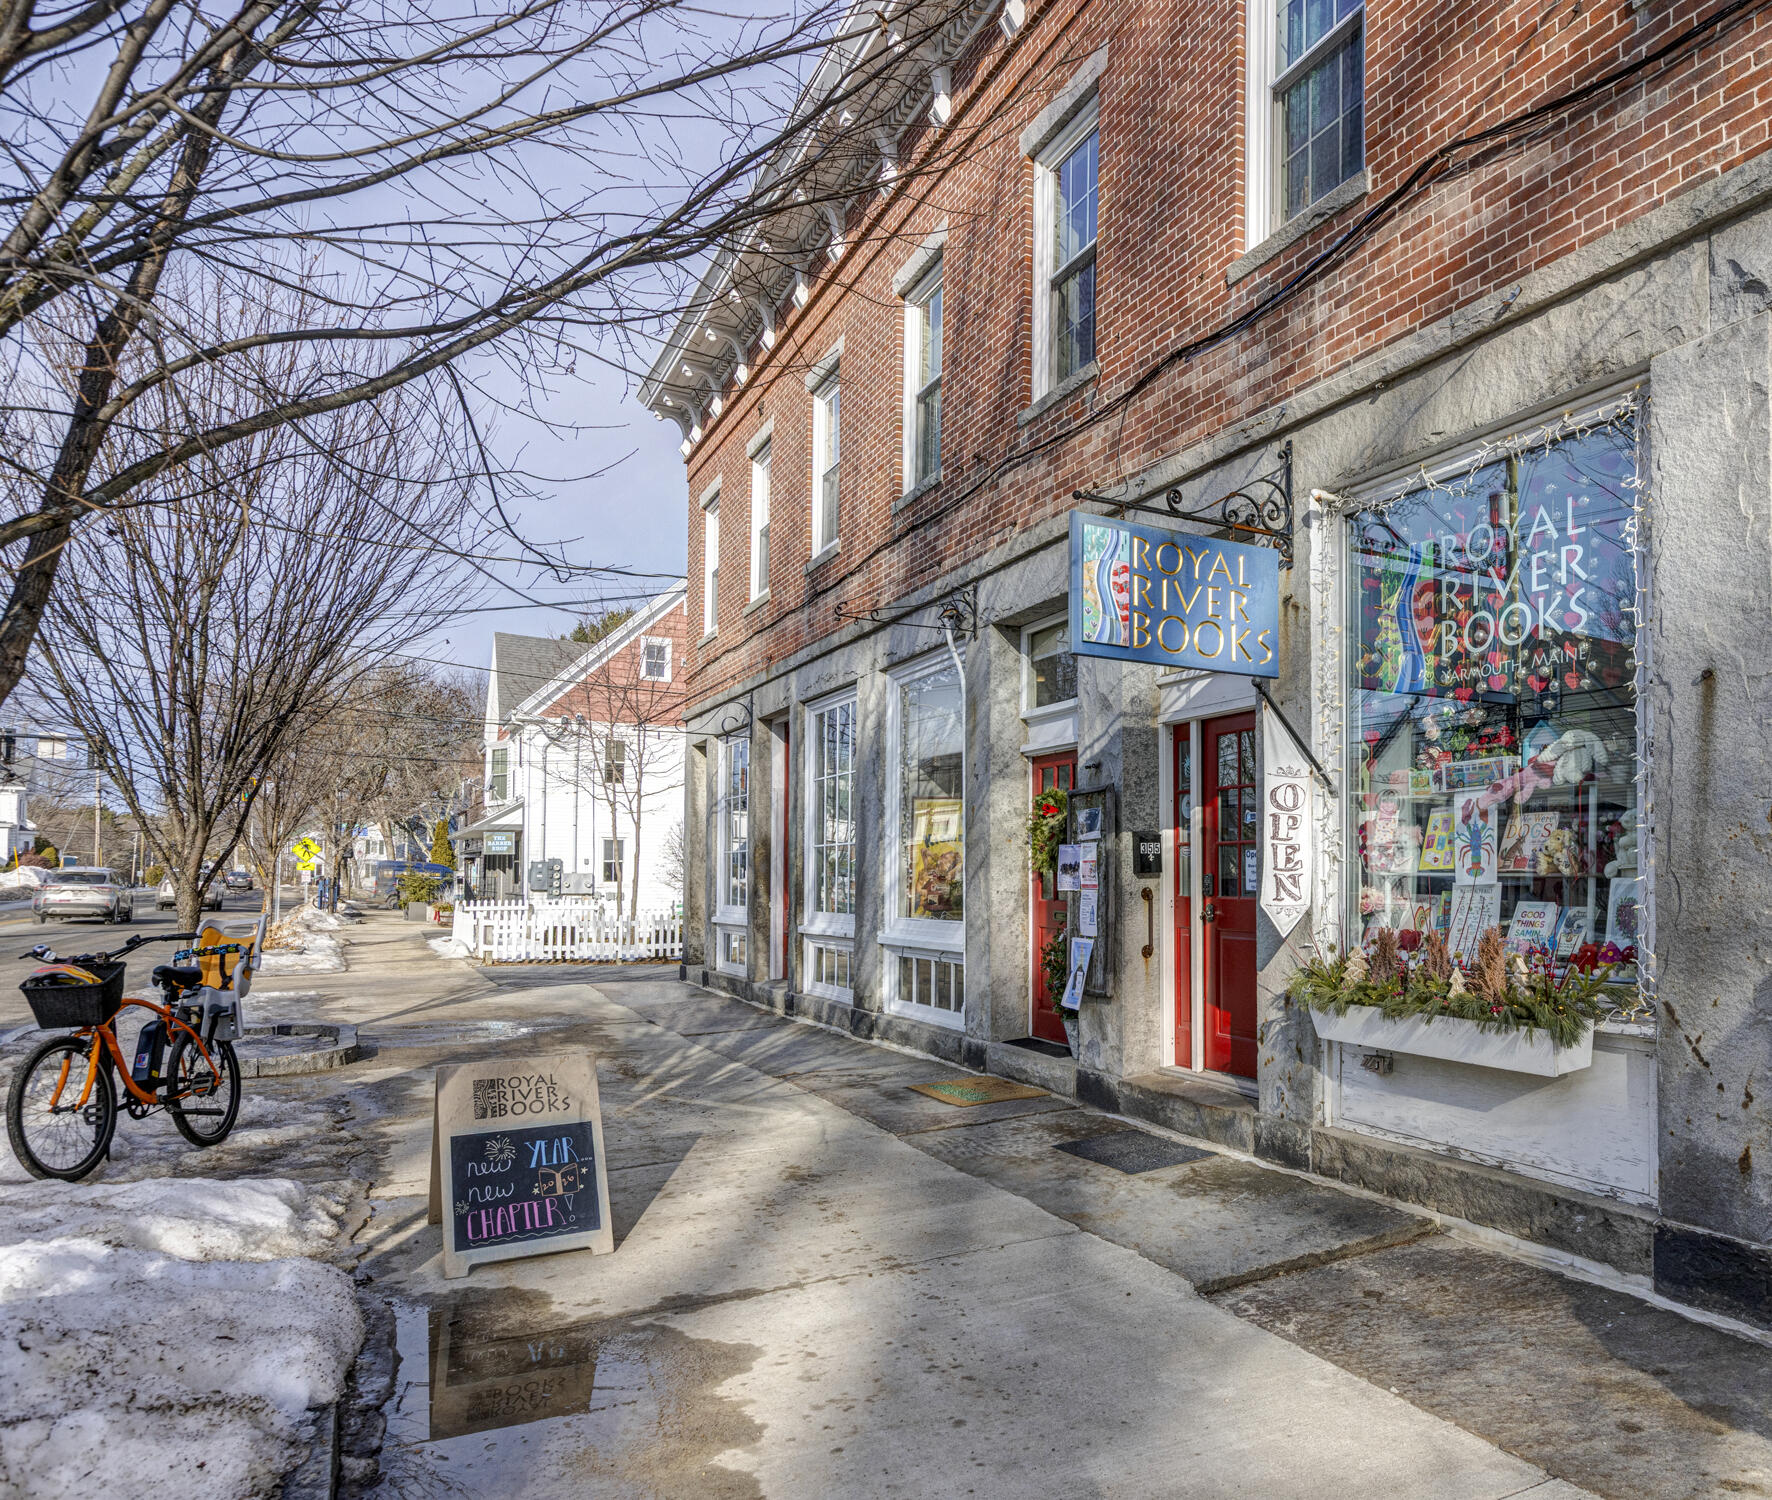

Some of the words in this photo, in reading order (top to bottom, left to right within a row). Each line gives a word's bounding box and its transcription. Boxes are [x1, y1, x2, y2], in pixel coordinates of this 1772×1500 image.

[1441, 495, 1587, 571] ROYAL
[1132, 535, 1252, 589] ROYAL
[1441, 544, 1588, 614] RIVER
[1132, 573, 1252, 623] RIVER
[1441, 587, 1588, 659] BOOKS
[1132, 609, 1273, 665] BOOKS
[1441, 661, 1522, 682] YARMOUTH
[1532, 649, 1587, 669] MAINE
[1507, 822, 1553, 839] DOGS
[1140, 842, 1160, 854] 355
[1269, 782, 1306, 902] OPEN
[1516, 919, 1545, 928] THINGS
[1520, 910, 1545, 919] GOOD
[496, 1073, 558, 1090] ROYAL
[497, 1086, 559, 1102] RIVER
[498, 1096, 571, 1118] BOOKS
[467, 1159, 512, 1178] new
[468, 1182, 515, 1203] new
